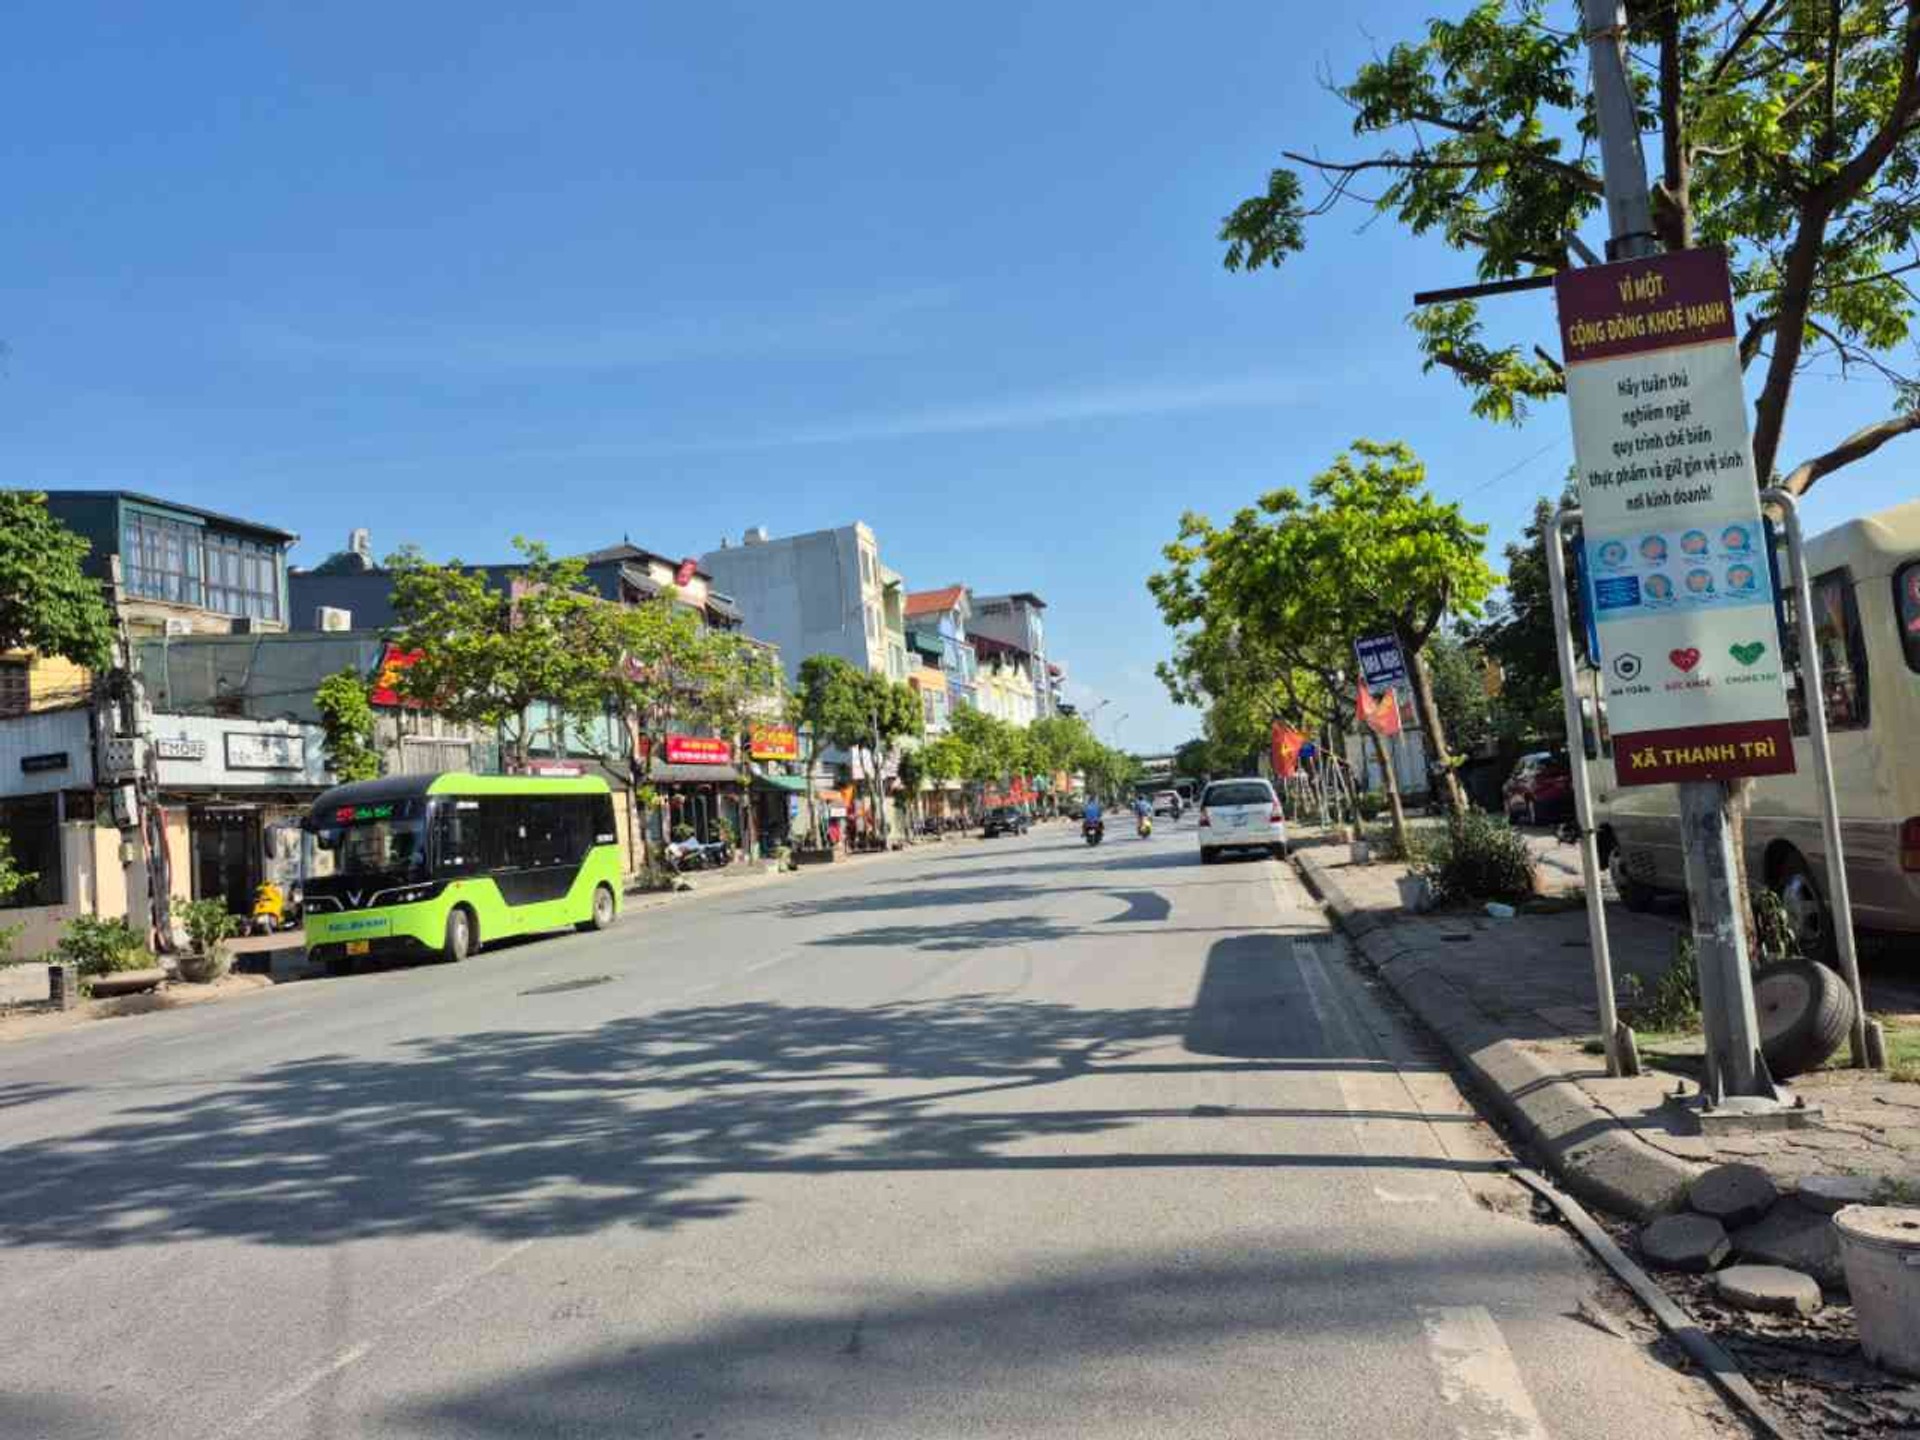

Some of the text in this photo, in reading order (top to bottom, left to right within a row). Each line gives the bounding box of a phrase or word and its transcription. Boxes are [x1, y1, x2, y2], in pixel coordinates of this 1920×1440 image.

[1619, 270, 1663, 303] VÌ MỘT
[1570, 319, 1606, 350] CỘNG
[1608, 313, 1645, 339] ĐỒNG
[1686, 302, 1727, 332] MẠNH
[1642, 374, 1667, 393] tuân
[1668, 368, 1688, 388] thủ
[1622, 400, 1691, 428] nghiêm ngặt
[1612, 426, 1712, 458] quy trình chế biến
[1589, 471, 1614, 489] thực
[1616, 462, 1647, 487] phẩm
[1649, 461, 1663, 478] và
[1664, 458, 1682, 480] giữ
[1703, 452, 1717, 475] vệ
[1719, 451, 1743, 469] sinh
[1646, 491, 1671, 507] kinh
[1631, 737, 1776, 769] XÃ THANH TRÌ
